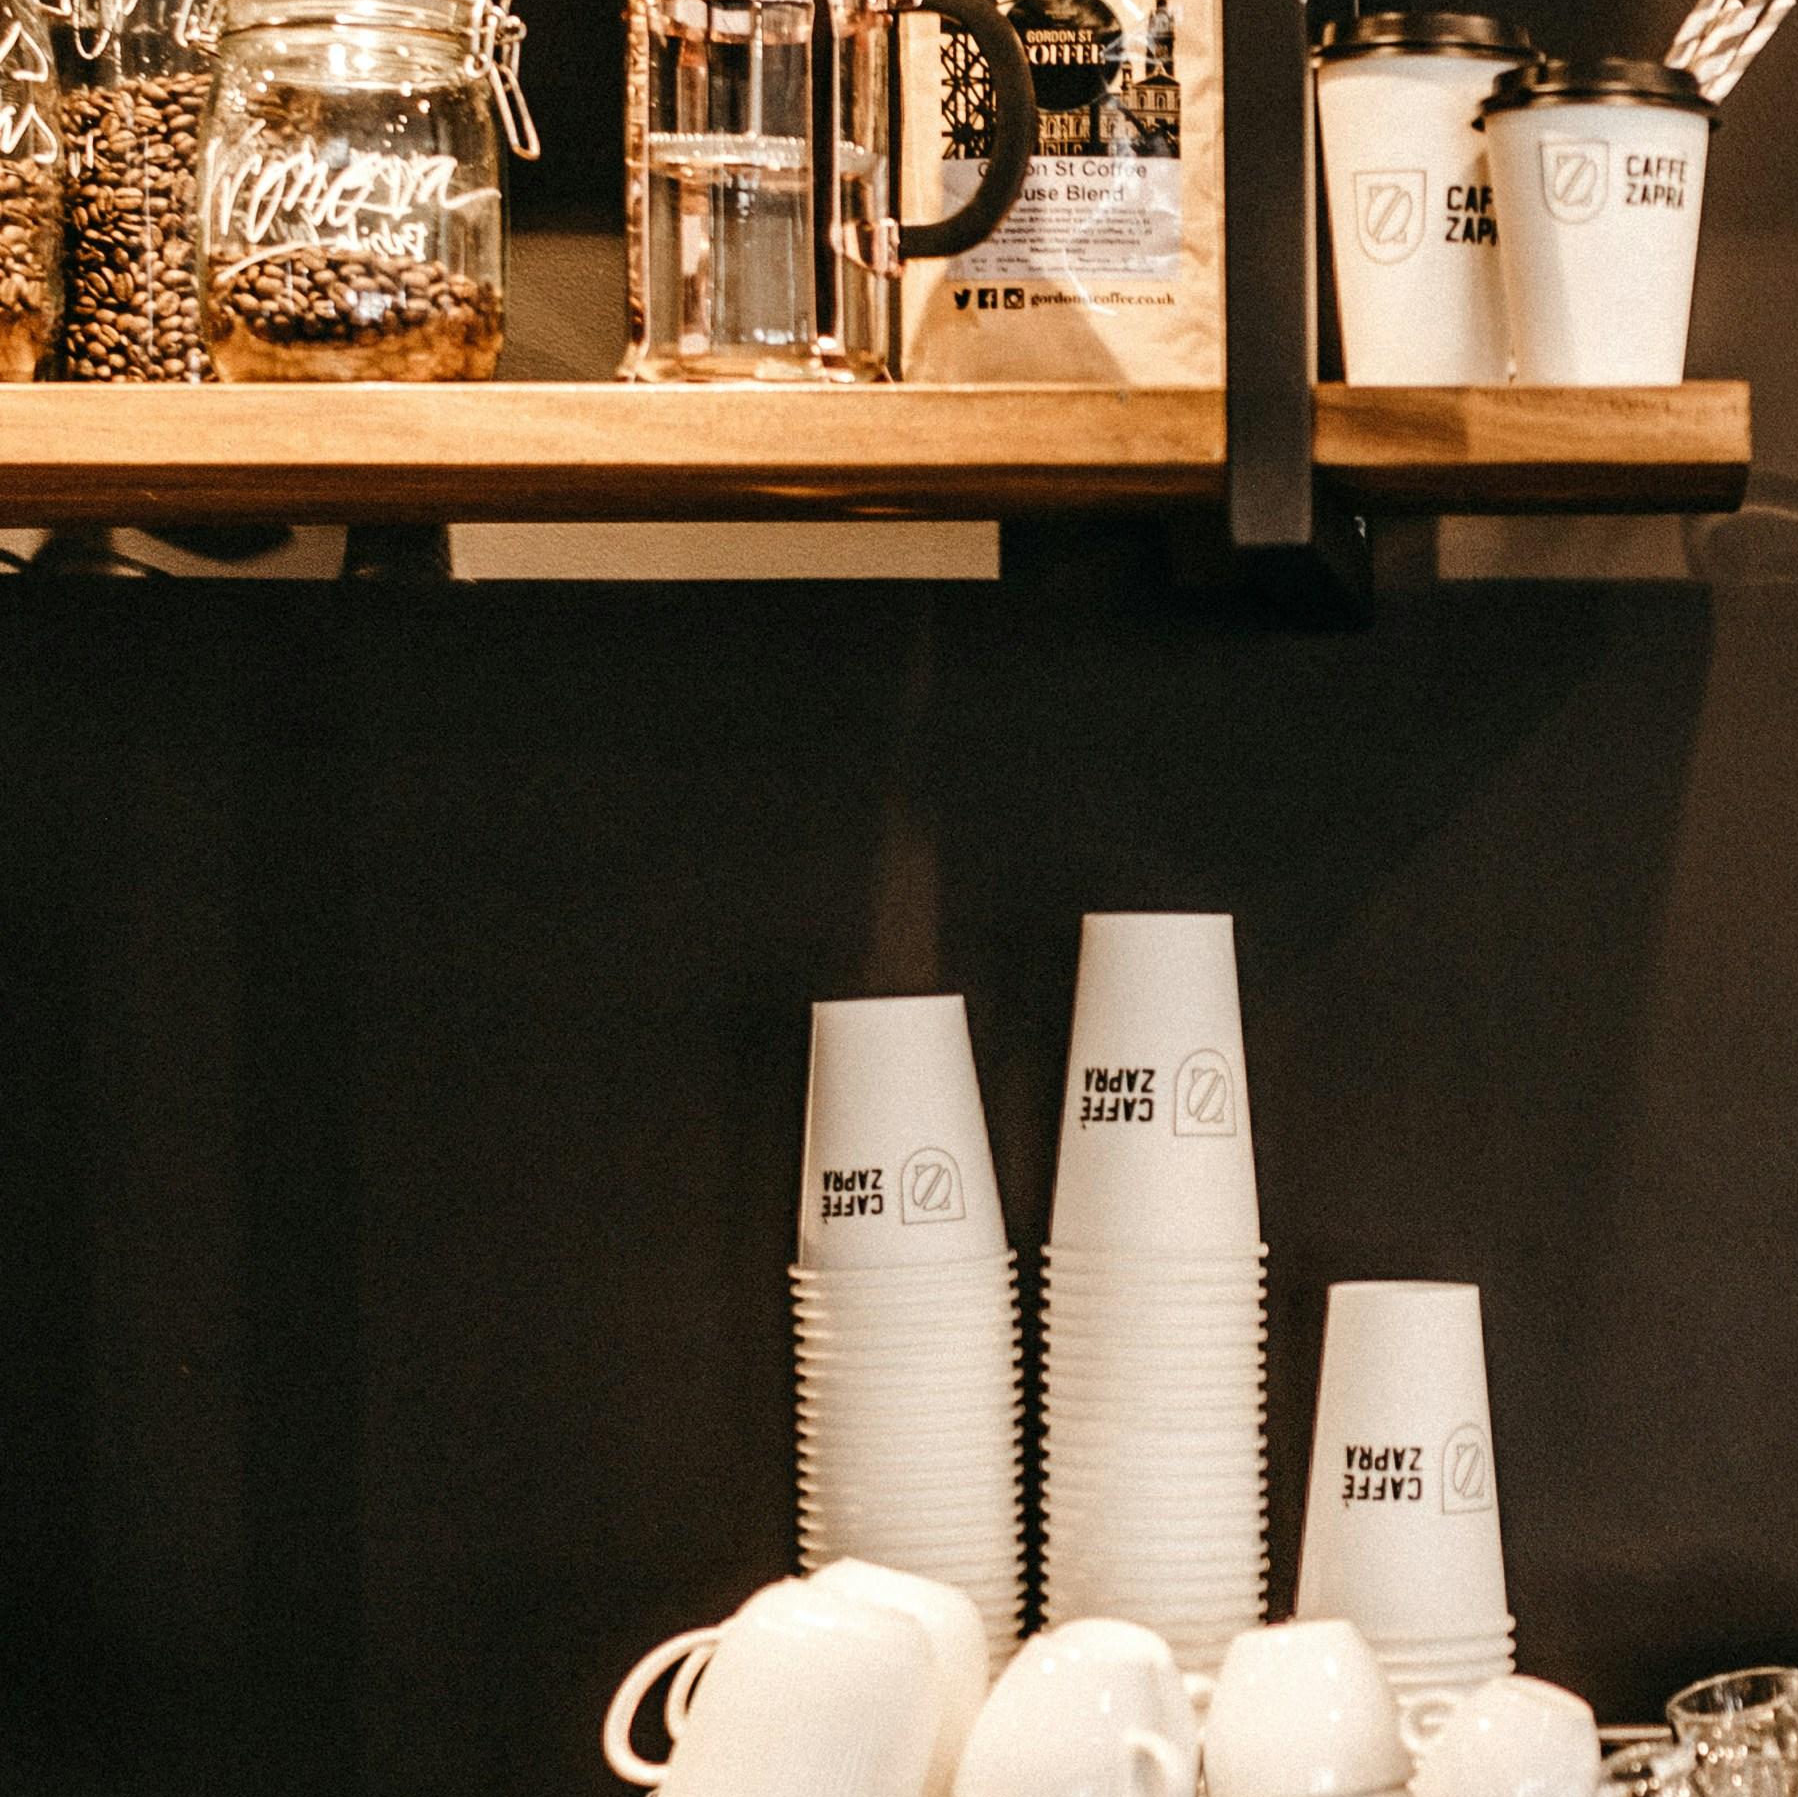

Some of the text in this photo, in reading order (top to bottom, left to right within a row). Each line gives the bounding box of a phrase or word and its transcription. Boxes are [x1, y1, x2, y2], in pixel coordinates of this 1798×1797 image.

[1026, 29, 1094, 43] GORDON ST
[1025, 43, 1106, 65] OFFEE
[1055, 160, 1075, 178] St
[1066, 185, 1124, 202] Blend
[1446, 186, 1494, 215] CAF
[1625, 182, 1685, 209] ZAPRA
[1084, 1068, 1155, 1093] ZAPRA
[822, 1168, 883, 1192] ZAPRA
[1346, 1446, 1421, 1472] ZAPRA
